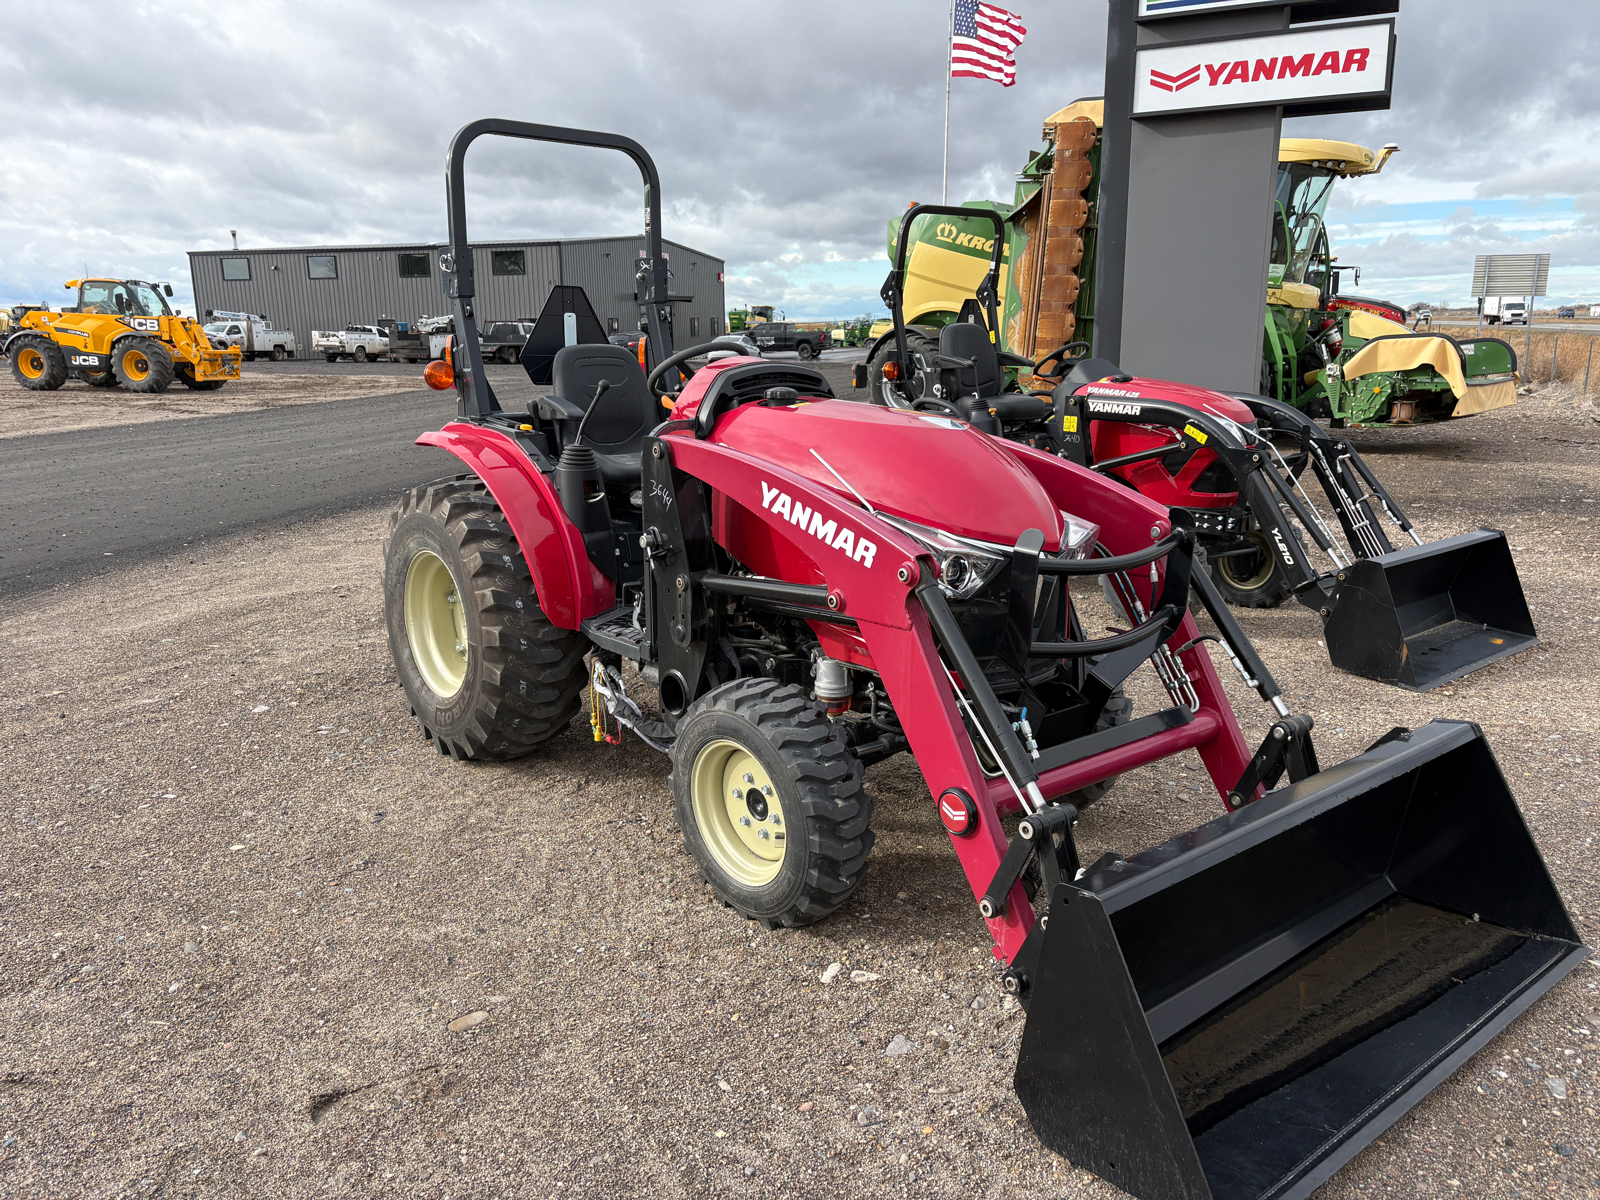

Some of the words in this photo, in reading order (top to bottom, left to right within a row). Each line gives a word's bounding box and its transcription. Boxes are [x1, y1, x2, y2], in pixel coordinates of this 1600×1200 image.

[1204, 47, 1370, 86] YANMAR
[71, 355, 99, 366] JCB
[1086, 386, 1127, 397] YANMAR
[1088, 401, 1142, 416] YANMAR
[760, 480, 878, 569] YANMAR
[1271, 526, 1294, 565] YL210
